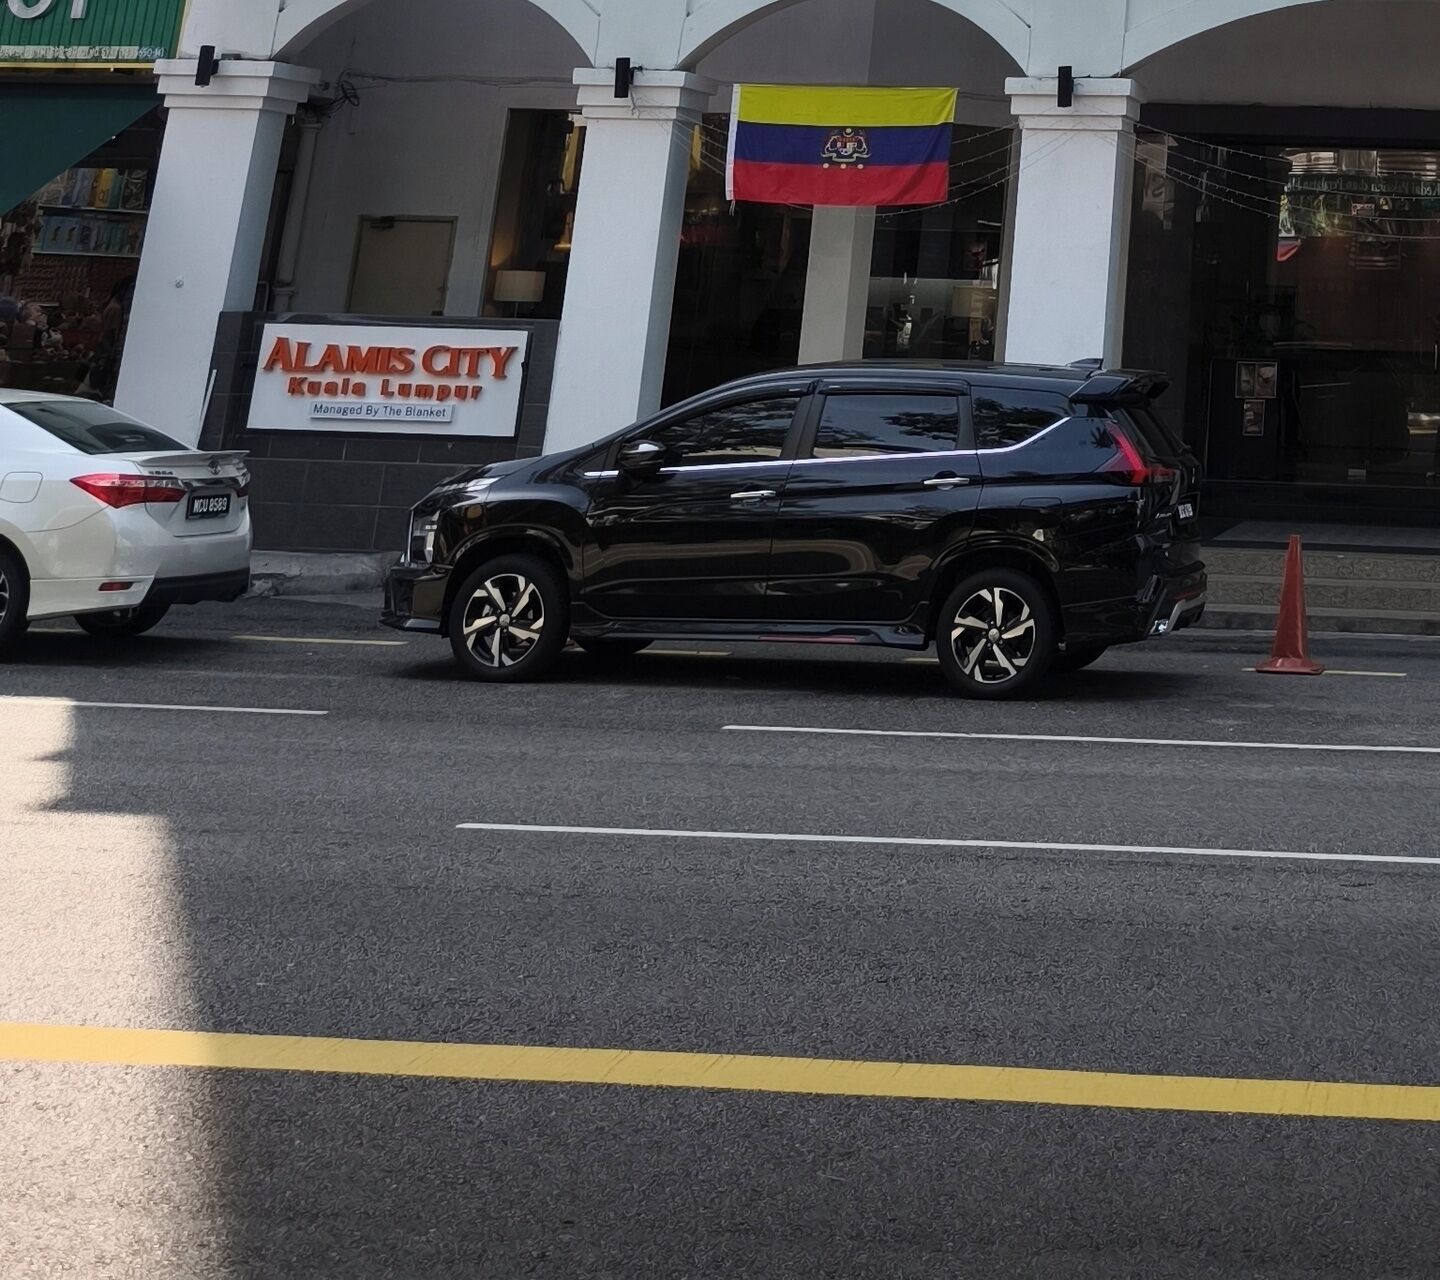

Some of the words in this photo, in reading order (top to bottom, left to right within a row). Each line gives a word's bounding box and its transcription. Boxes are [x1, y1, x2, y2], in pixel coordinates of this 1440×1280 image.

[263, 336, 416, 375] ALAMIS
[421, 345, 519, 380] CITY
[287, 376, 367, 397] Kuala
[380, 379, 484, 403] Lumpur
[313, 403, 362, 416] Managed
[366, 405, 380, 417] By
[383, 406, 403, 417] The
[405, 406, 447, 418] Blanket
